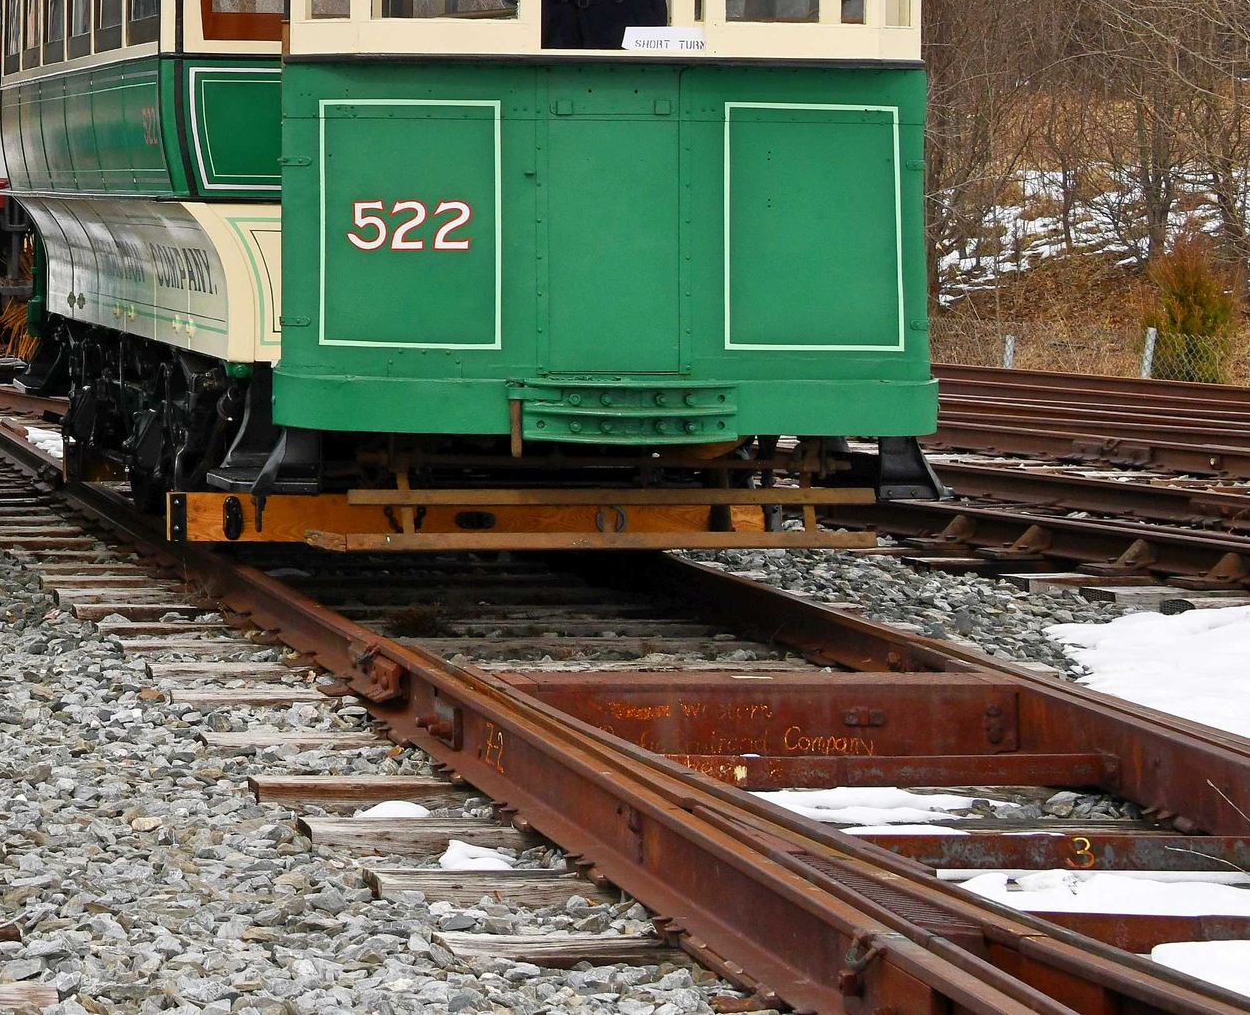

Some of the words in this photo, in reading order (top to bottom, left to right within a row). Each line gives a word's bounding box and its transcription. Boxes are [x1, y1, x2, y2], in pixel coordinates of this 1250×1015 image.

[635, 39, 670, 49] SHORT
[347, 199, 472, 251] 522
[784, 725, 874, 757] Company
[1066, 837, 1095, 869] 3
